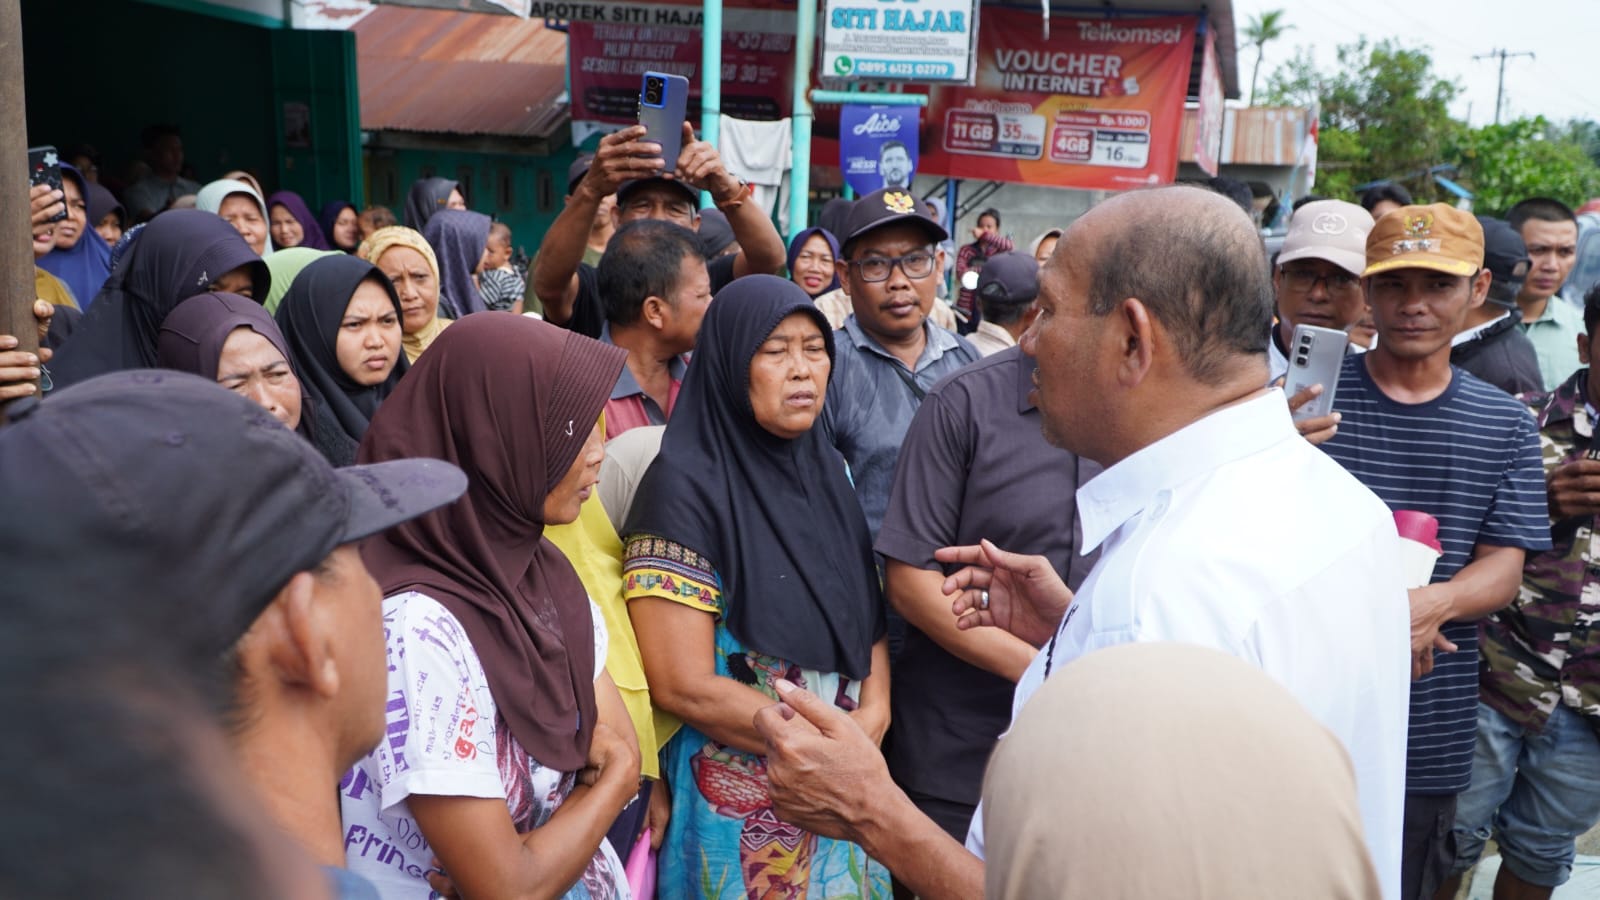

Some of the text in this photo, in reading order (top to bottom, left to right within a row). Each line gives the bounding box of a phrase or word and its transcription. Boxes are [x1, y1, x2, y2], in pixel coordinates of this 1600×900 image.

[531, 2, 704, 27] APOTEK SITI HAJA
[832, 8, 966, 33] SITI HAJAR
[1077, 22, 1182, 43] Telkomsel
[995, 48, 1122, 78] VOUCHER
[1004, 73, 1104, 96] INTERNET
[853, 112, 901, 135] Aice
[953, 123, 994, 141] 11 GB
[1003, 122, 1022, 140] 35
[1057, 137, 1090, 153] 4GB
[1106, 146, 1124, 161] 16
